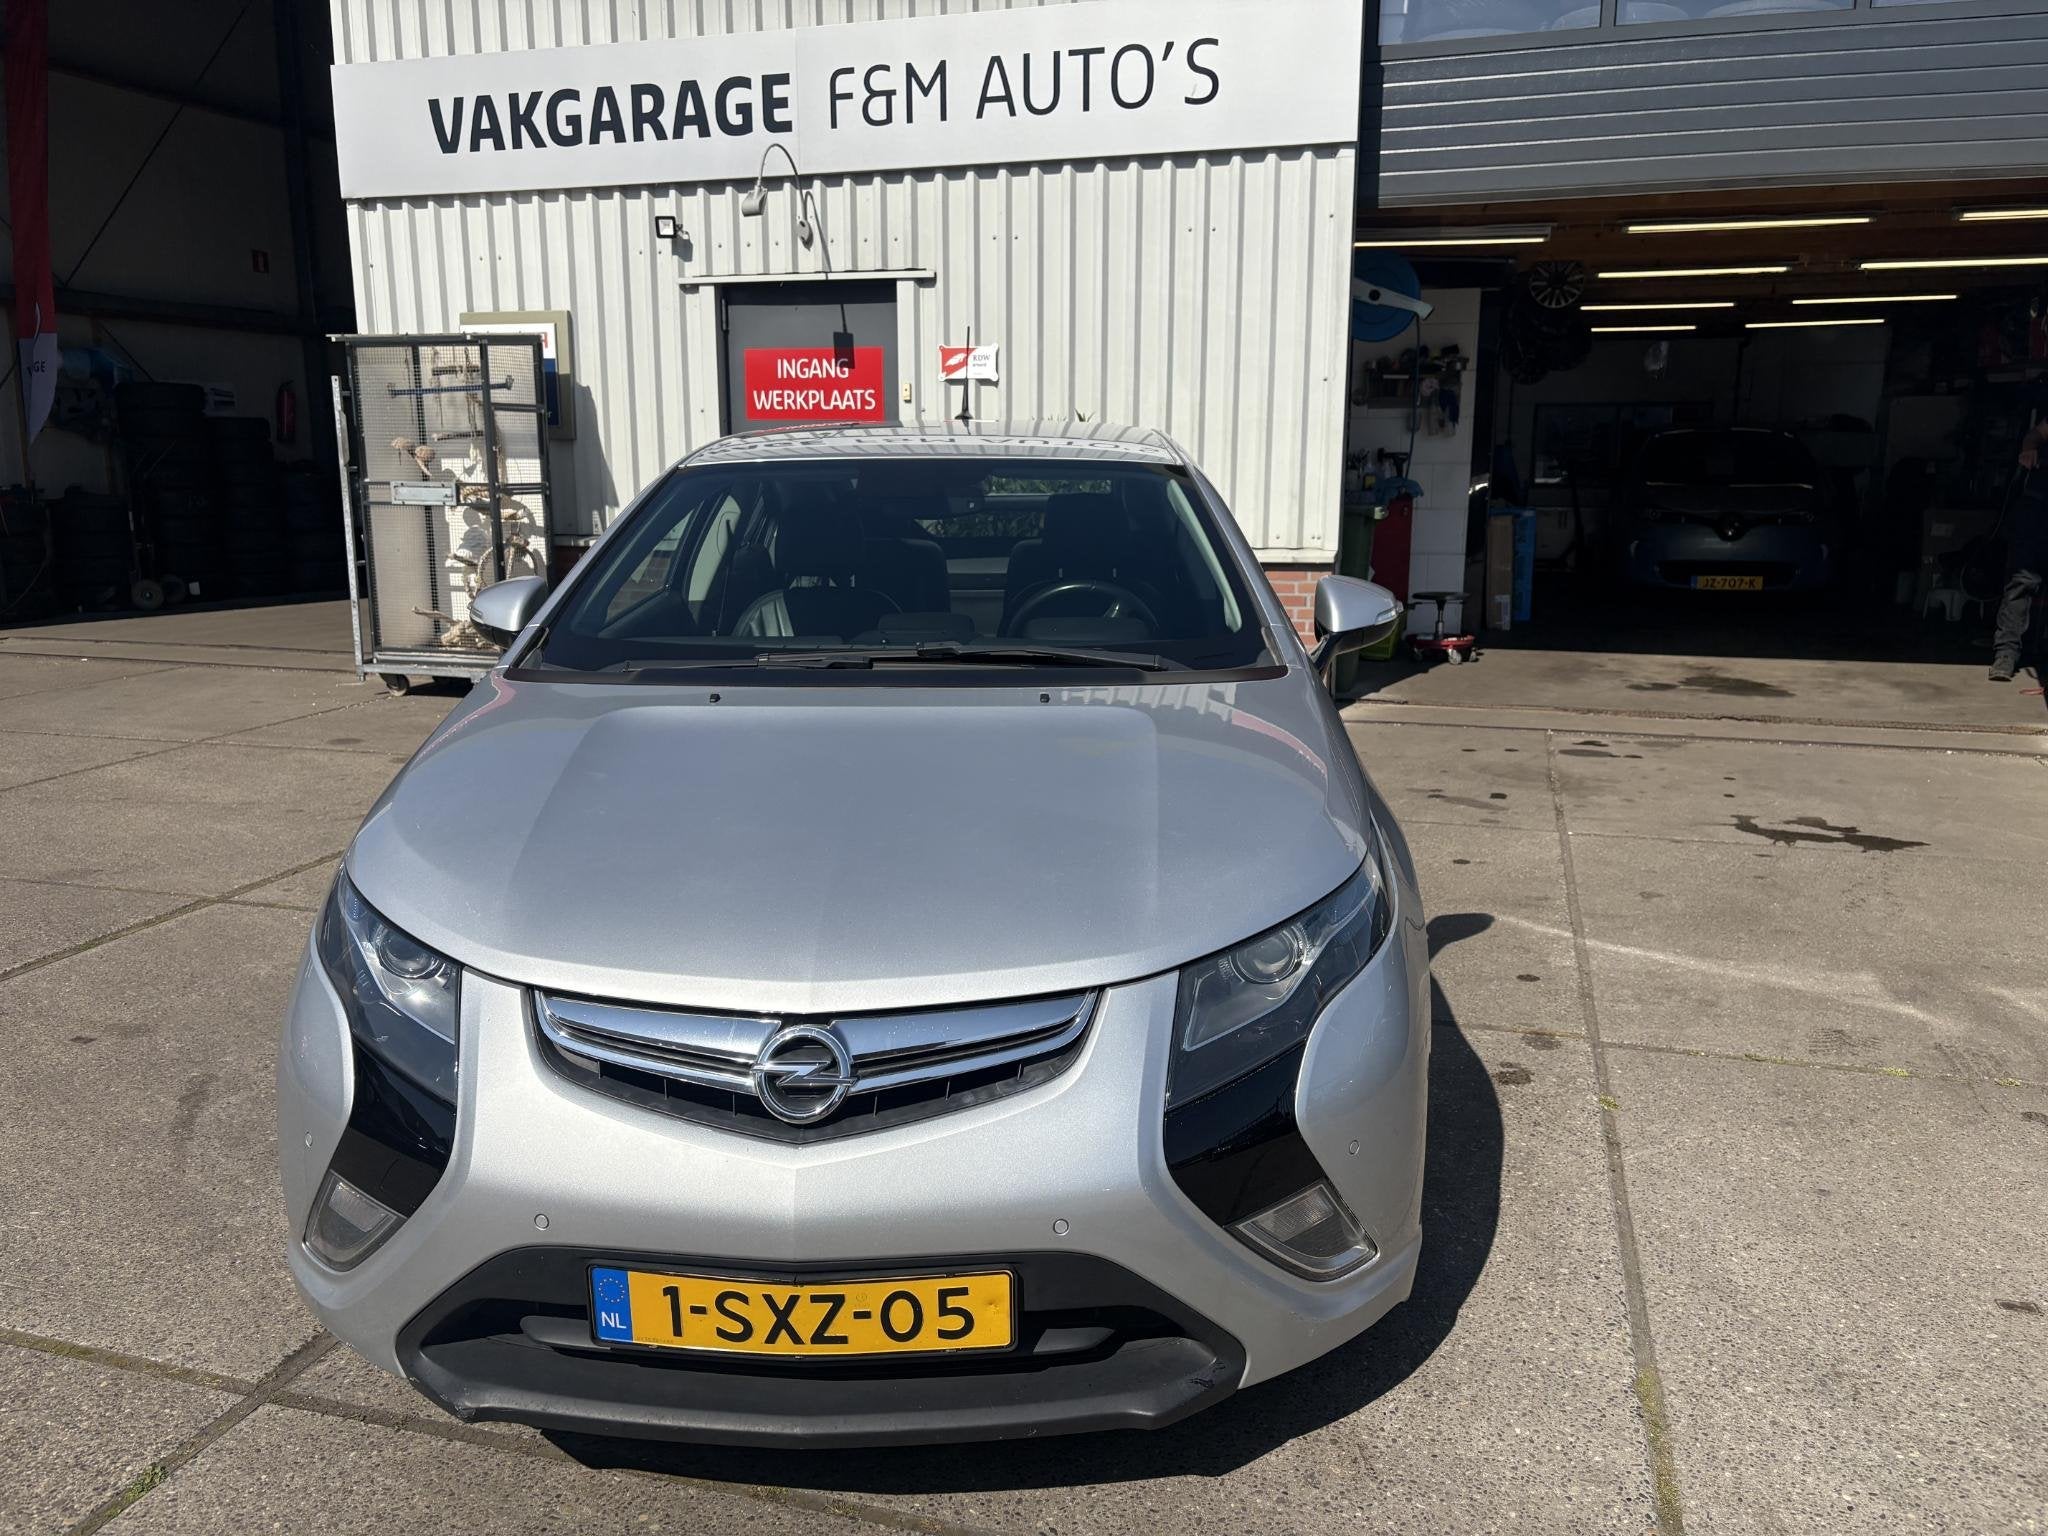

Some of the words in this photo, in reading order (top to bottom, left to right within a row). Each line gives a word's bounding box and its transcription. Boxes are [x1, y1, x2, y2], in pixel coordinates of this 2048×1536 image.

[428, 73, 792, 154] VAKGARAGE
[830, 60, 947, 129] F&M
[976, 38, 1219, 119] AUTO'S
[777, 358, 849, 379] INGANG
[753, 389, 876, 410] WERKPLAATS
[601, 1311, 627, 1329] NL
[662, 1286, 975, 1345] 1-SXZ-05
